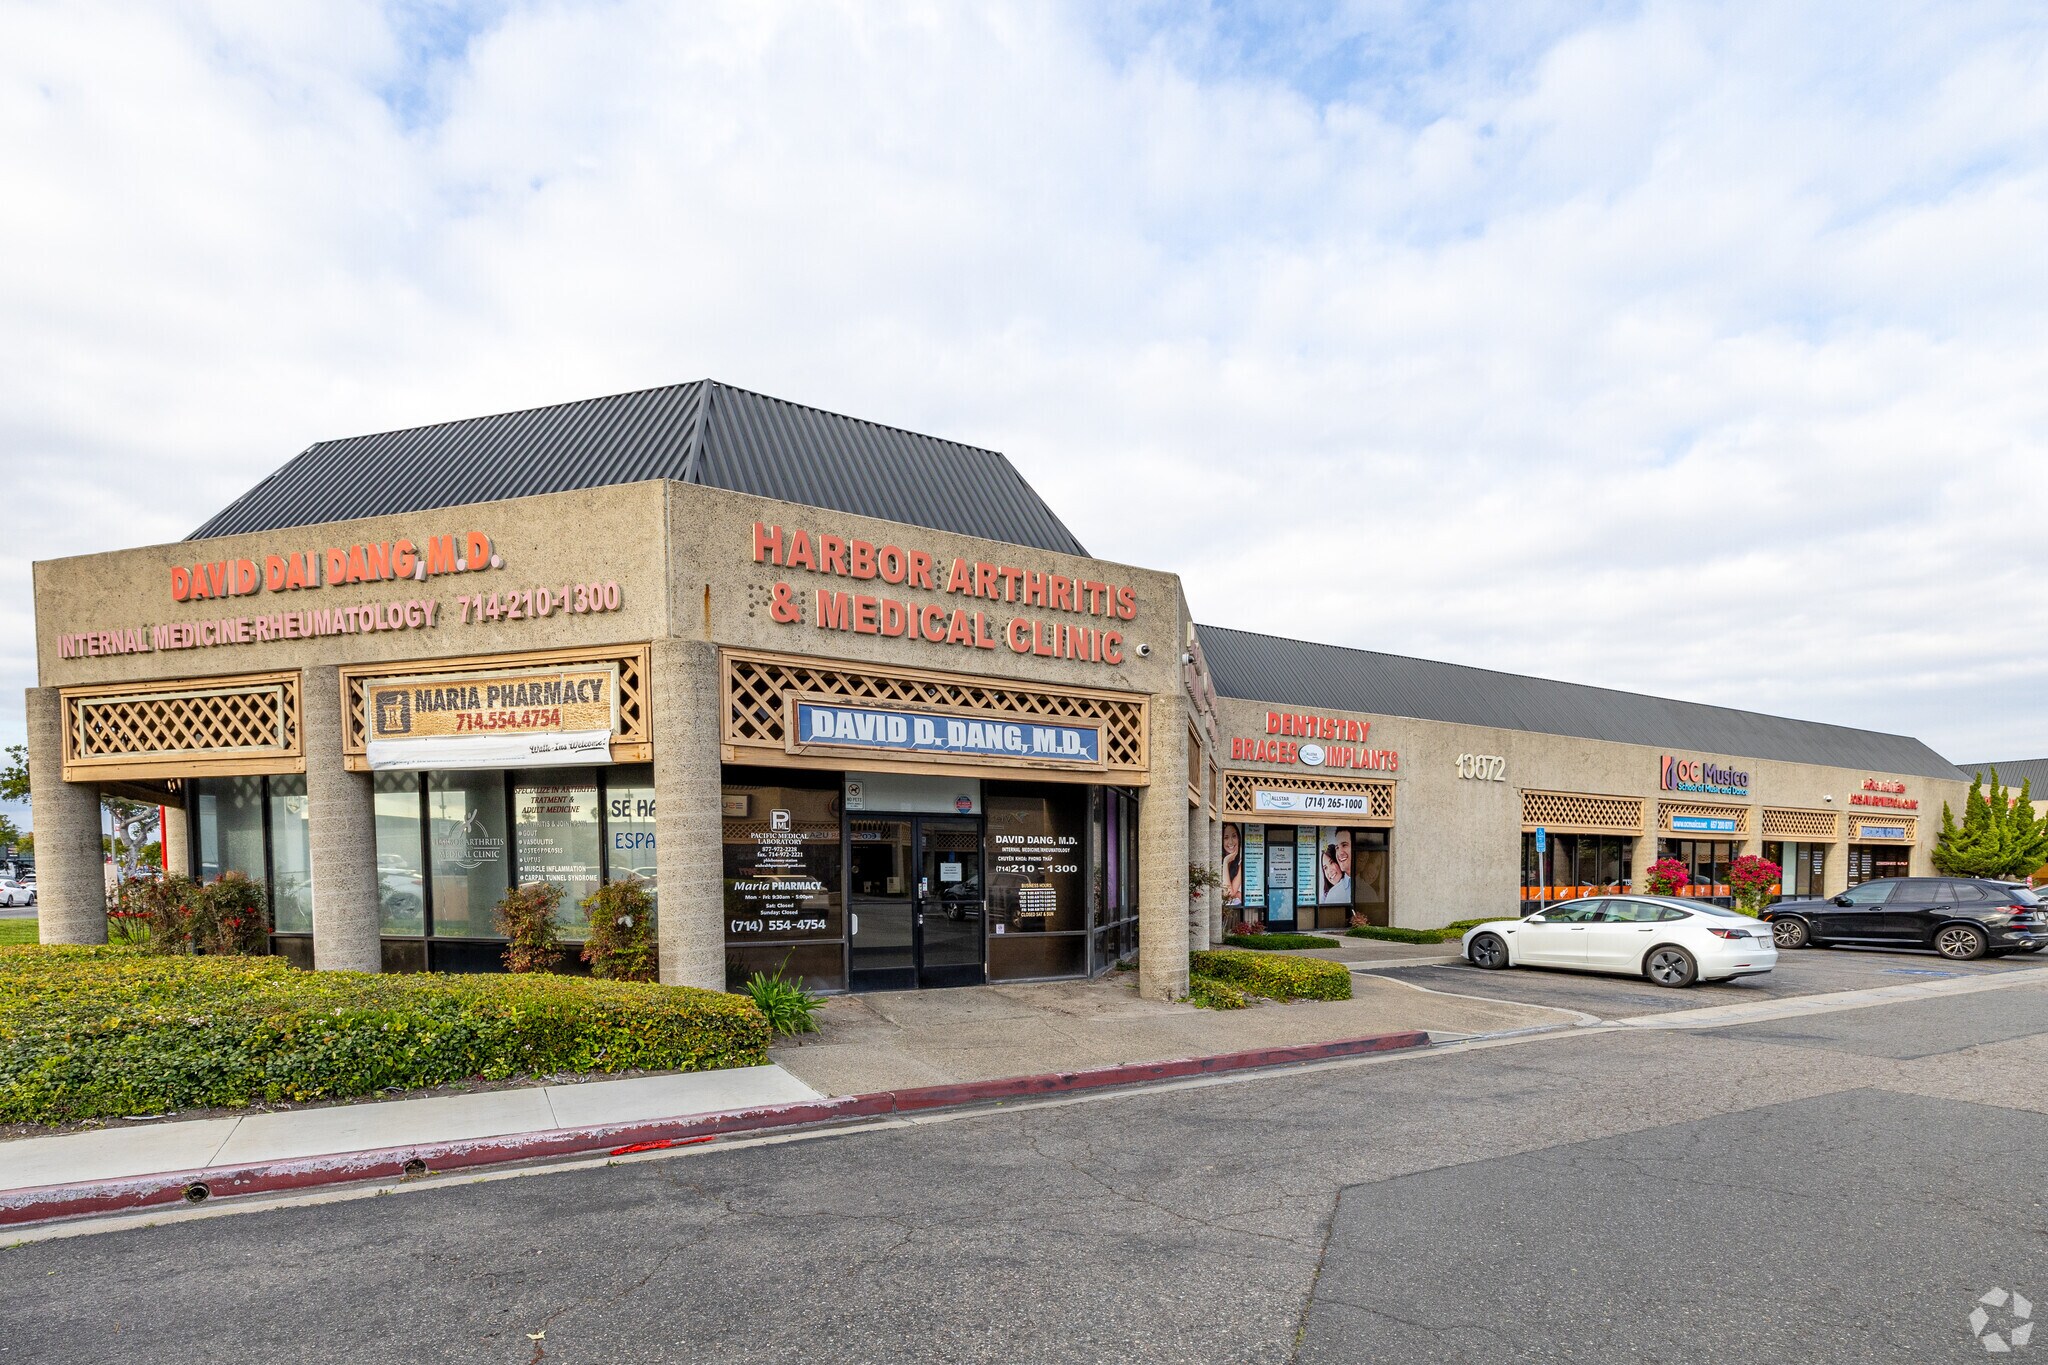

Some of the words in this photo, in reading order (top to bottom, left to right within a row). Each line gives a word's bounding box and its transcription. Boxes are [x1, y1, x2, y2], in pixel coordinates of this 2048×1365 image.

[171, 558, 260, 602] DAVID
[266, 551, 320, 592] DAI
[753, 521, 933, 590] HARBOR
[946, 557, 1137, 620] ARTHRITIS
[57, 627, 151, 658] INTERNAL
[458, 581, 621, 623] 714-210-1300
[770, 581, 800, 623] &
[816, 589, 995, 649] MEDICAL
[1007, 617, 1123, 665] CLINIC
[414, 686, 481, 713] MARIA
[487, 678, 603, 708] PHARMACY
[456, 708, 561, 731] 714.554.4754
[1266, 711, 1371, 742] DENTISTRY
[811, 709, 907, 742] DAVID
[913, 717, 943, 746] D.
[947, 720, 1029, 754] DANG,
[1032, 727, 1087, 755] M.D.
[529, 741, 567, 754] Walk-Ins
[1230, 737, 1298, 764] BRACES
[1325, 745, 1398, 772] IMPLANTS
[1455, 753, 1506, 781] 13872
[1677, 760, 1700, 782] OC
[514, 786, 551, 795] SPECIALIZE
[561, 785, 597, 793] ARTHRITIS
[1677, 782, 1697, 791] School
[1697, 784, 1704, 792] of
[1704, 785, 1720, 793] Music
[1720, 786, 1731, 794] and
[1732, 787, 1750, 796] Dance
[522, 806, 545, 814] ADULT
[611, 799, 631, 817] SE
[1305, 796, 1326, 810] (714)
[1327, 796, 1363, 810] 265-1000
[465, 838, 504, 846] ARTHRITIS
[995, 835, 1024, 844] DAVID
[1027, 836, 1056, 846] DANG,
[1058, 837, 1078, 845] M.D.
[440, 850, 471, 858] MEDICAL
[473, 850, 500, 858] CLINIC
[567, 873, 598, 881] SYNDROME
[1047, 864, 1077, 873] 1300
[734, 882, 770, 891] Maria
[772, 881, 822, 890] PHARMACY
[731, 920, 763, 933] (714)
[768, 919, 827, 931] 554-4754
